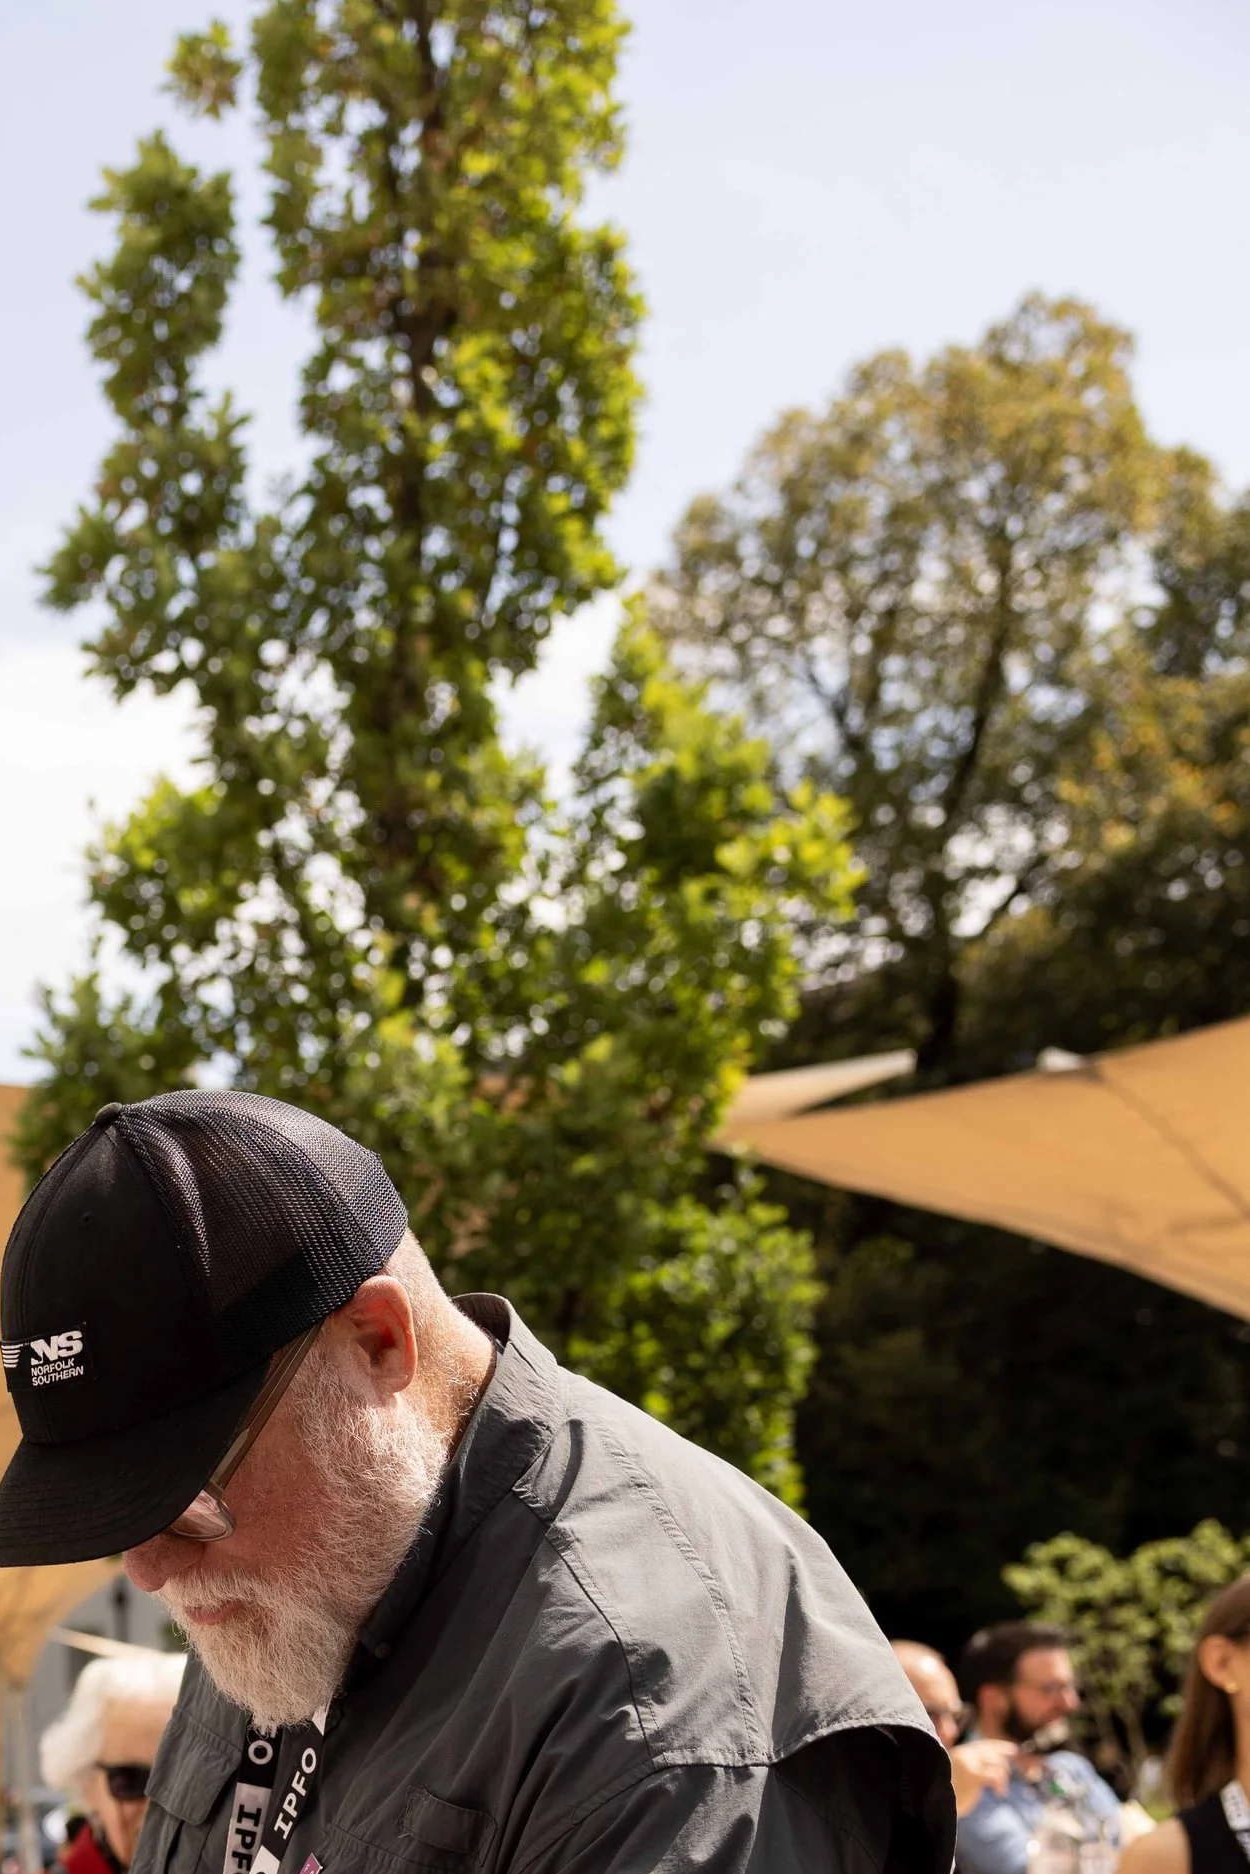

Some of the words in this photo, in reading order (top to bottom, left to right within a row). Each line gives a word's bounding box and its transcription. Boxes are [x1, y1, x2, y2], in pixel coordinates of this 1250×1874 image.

[30, 1330, 84, 1366] NS
[30, 1358, 75, 1377] NORFOLK
[32, 1365, 84, 1387] SOUTHERN
[273, 1747, 317, 1840] IPFO
